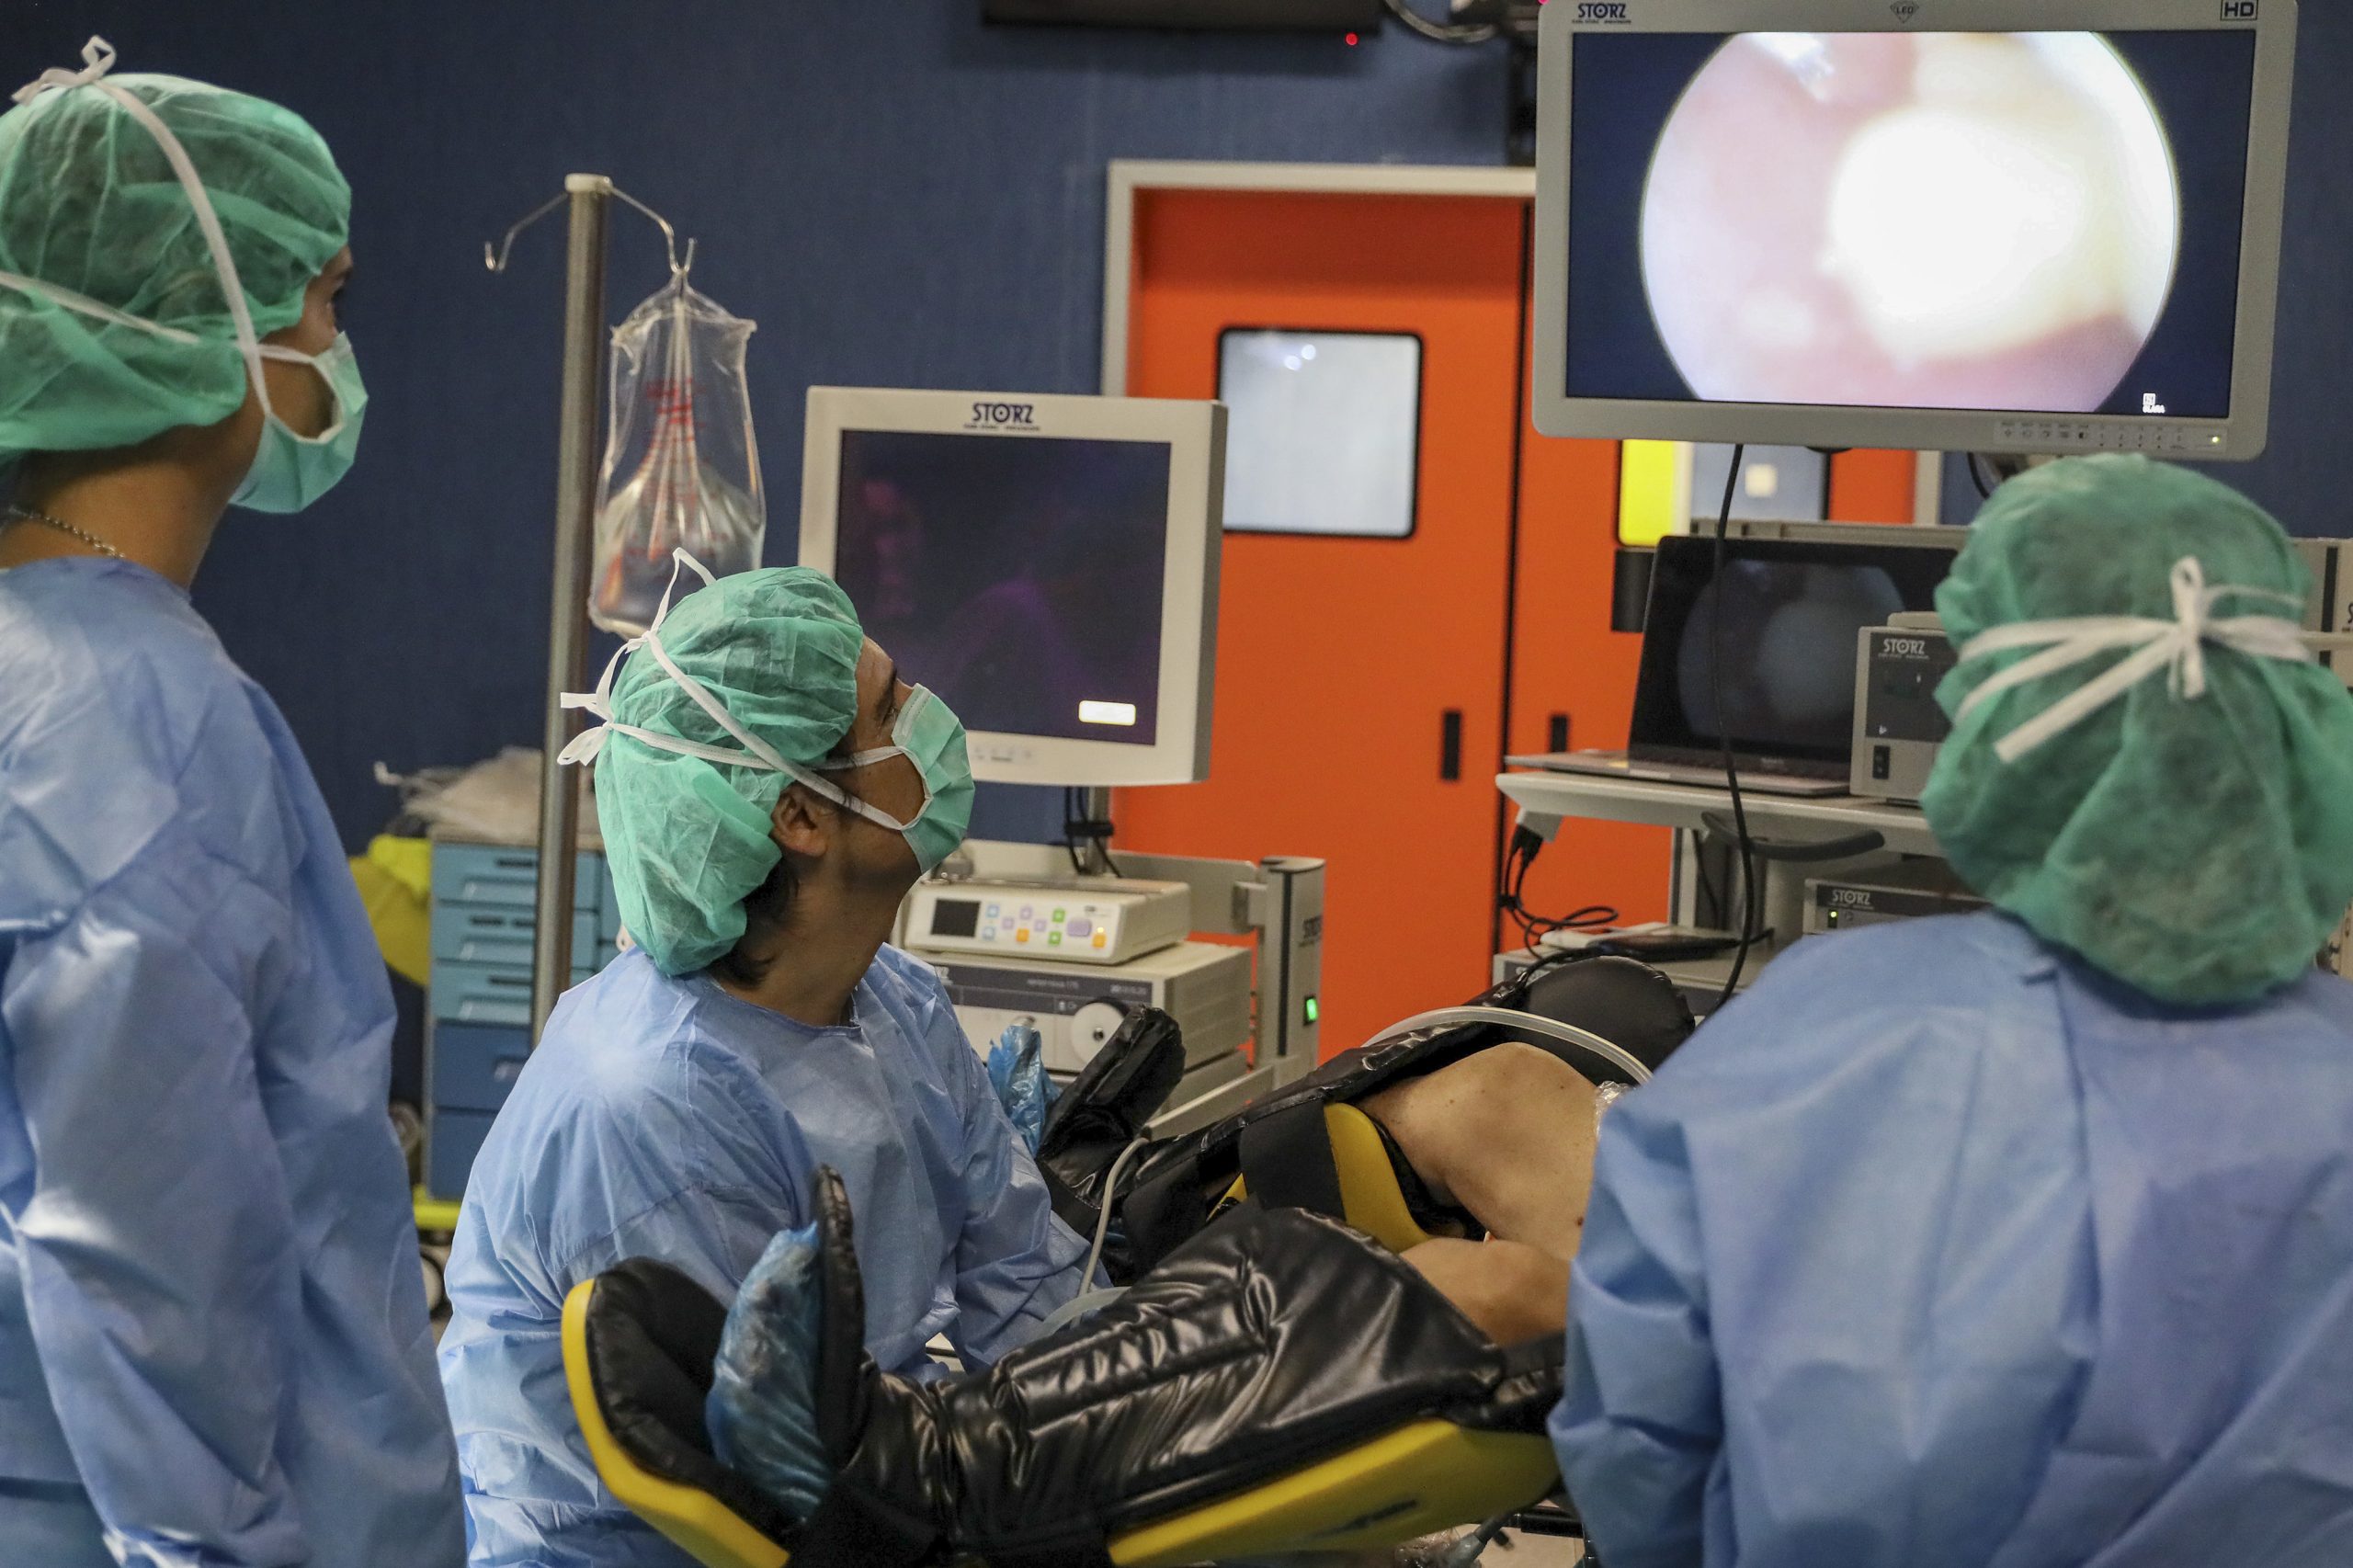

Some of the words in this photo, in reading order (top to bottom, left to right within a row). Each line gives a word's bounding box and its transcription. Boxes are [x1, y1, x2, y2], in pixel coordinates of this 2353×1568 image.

[1577, 3, 1626, 18] STORZ
[2224, 2, 2255, 17] HD
[972, 403, 1033, 424] STORZ
[1883, 638, 1926, 654] STORZ
[1832, 889, 1870, 905] STORZ
